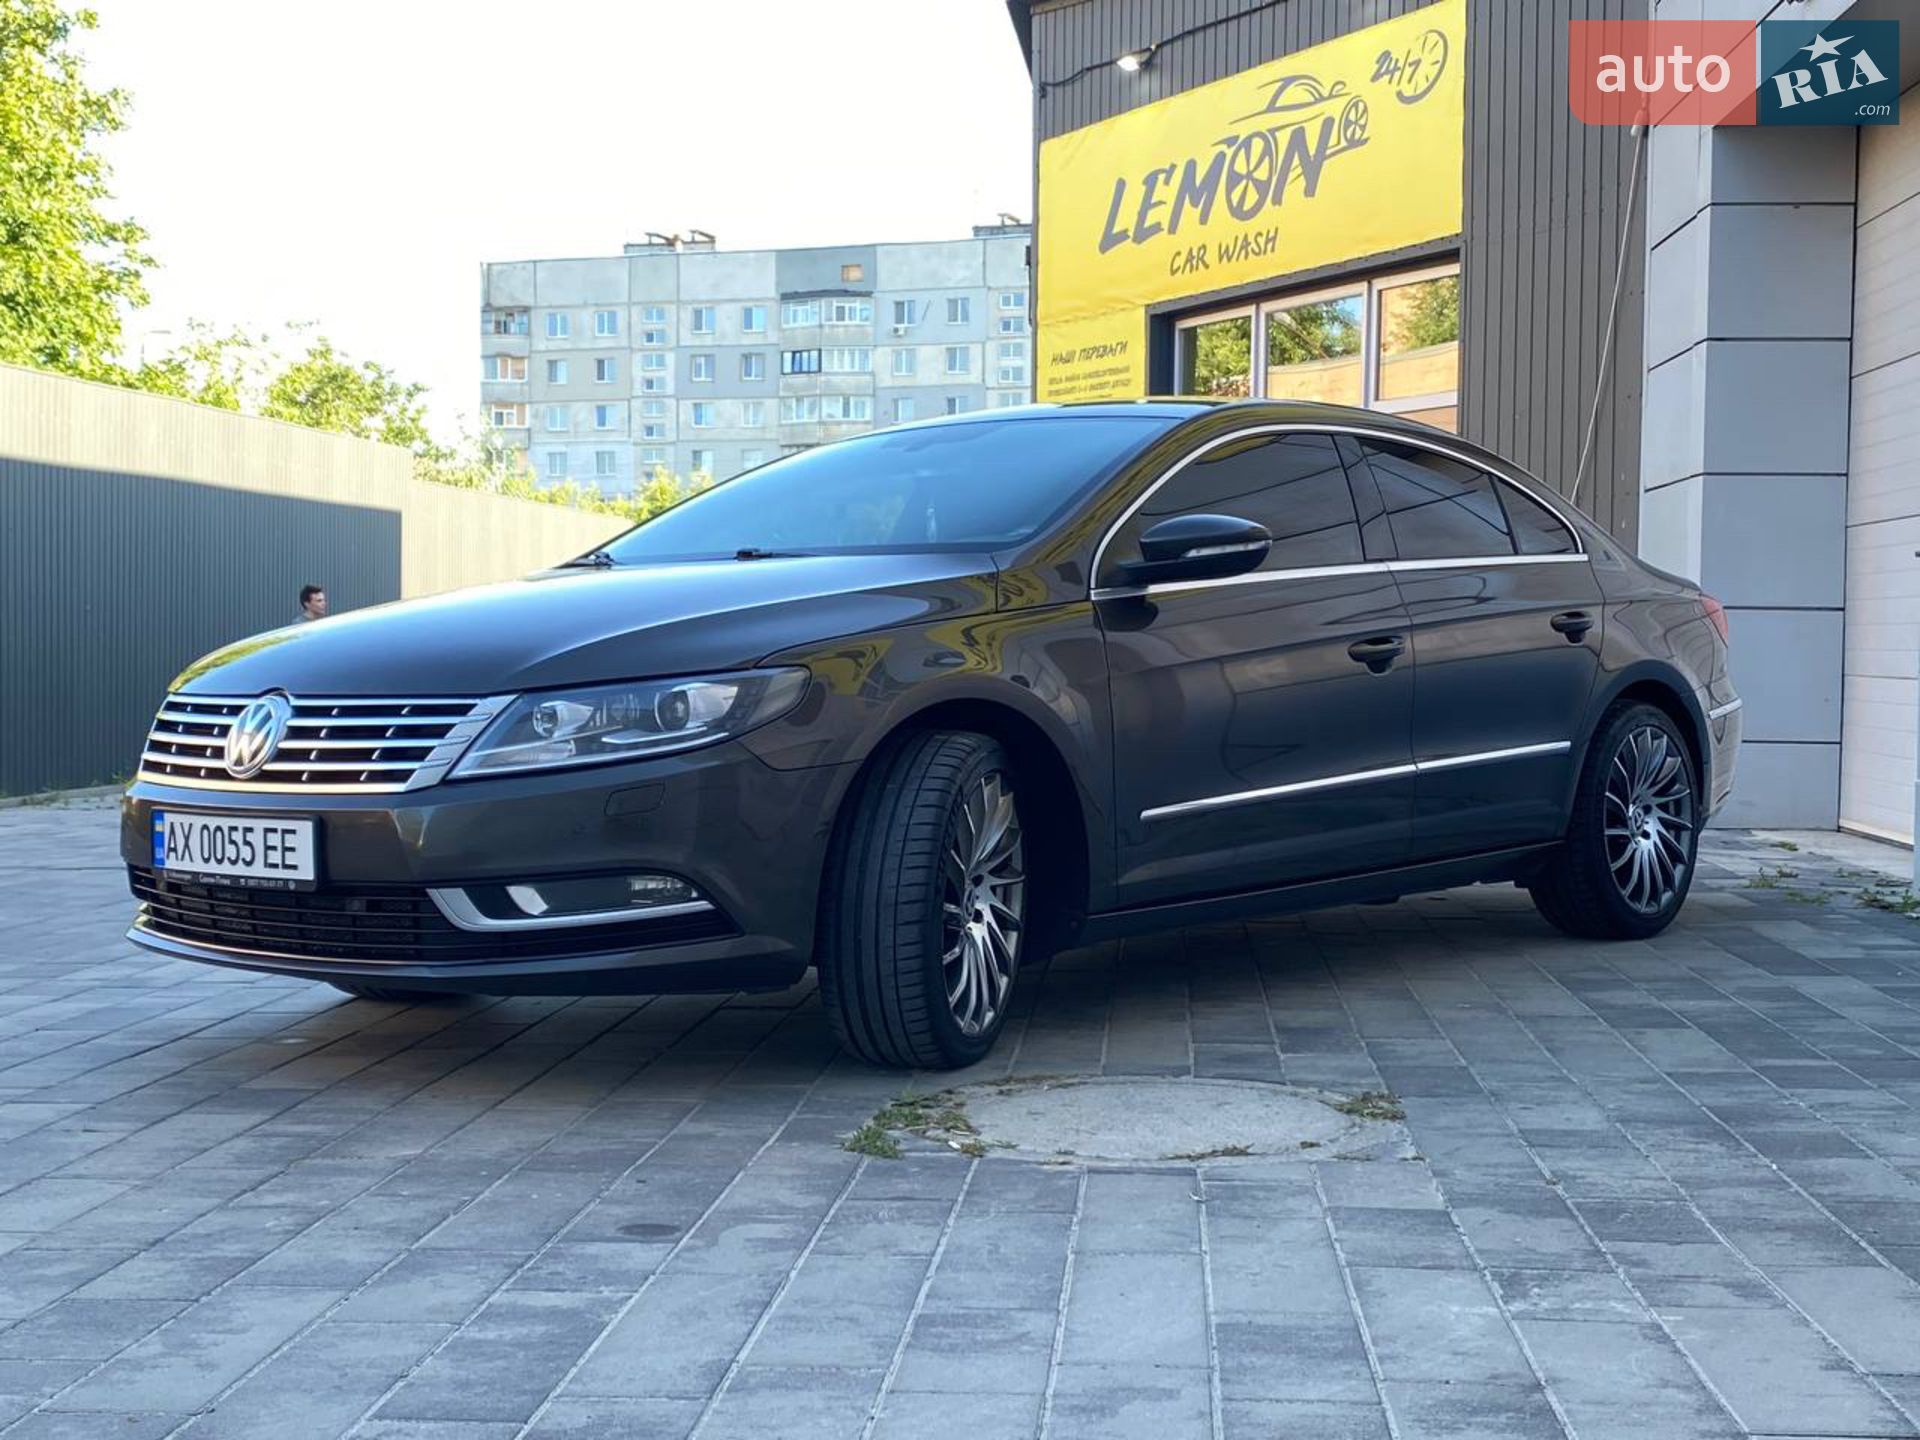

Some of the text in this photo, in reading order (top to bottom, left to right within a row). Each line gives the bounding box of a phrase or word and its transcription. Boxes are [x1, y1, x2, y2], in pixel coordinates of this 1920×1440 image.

[1370, 49, 1422, 87] 24/7
[1098, 116, 1335, 255] LEMON
[1170, 227, 1279, 277] CAR WASH
[166, 821, 299, 871] AX 0055 EE
